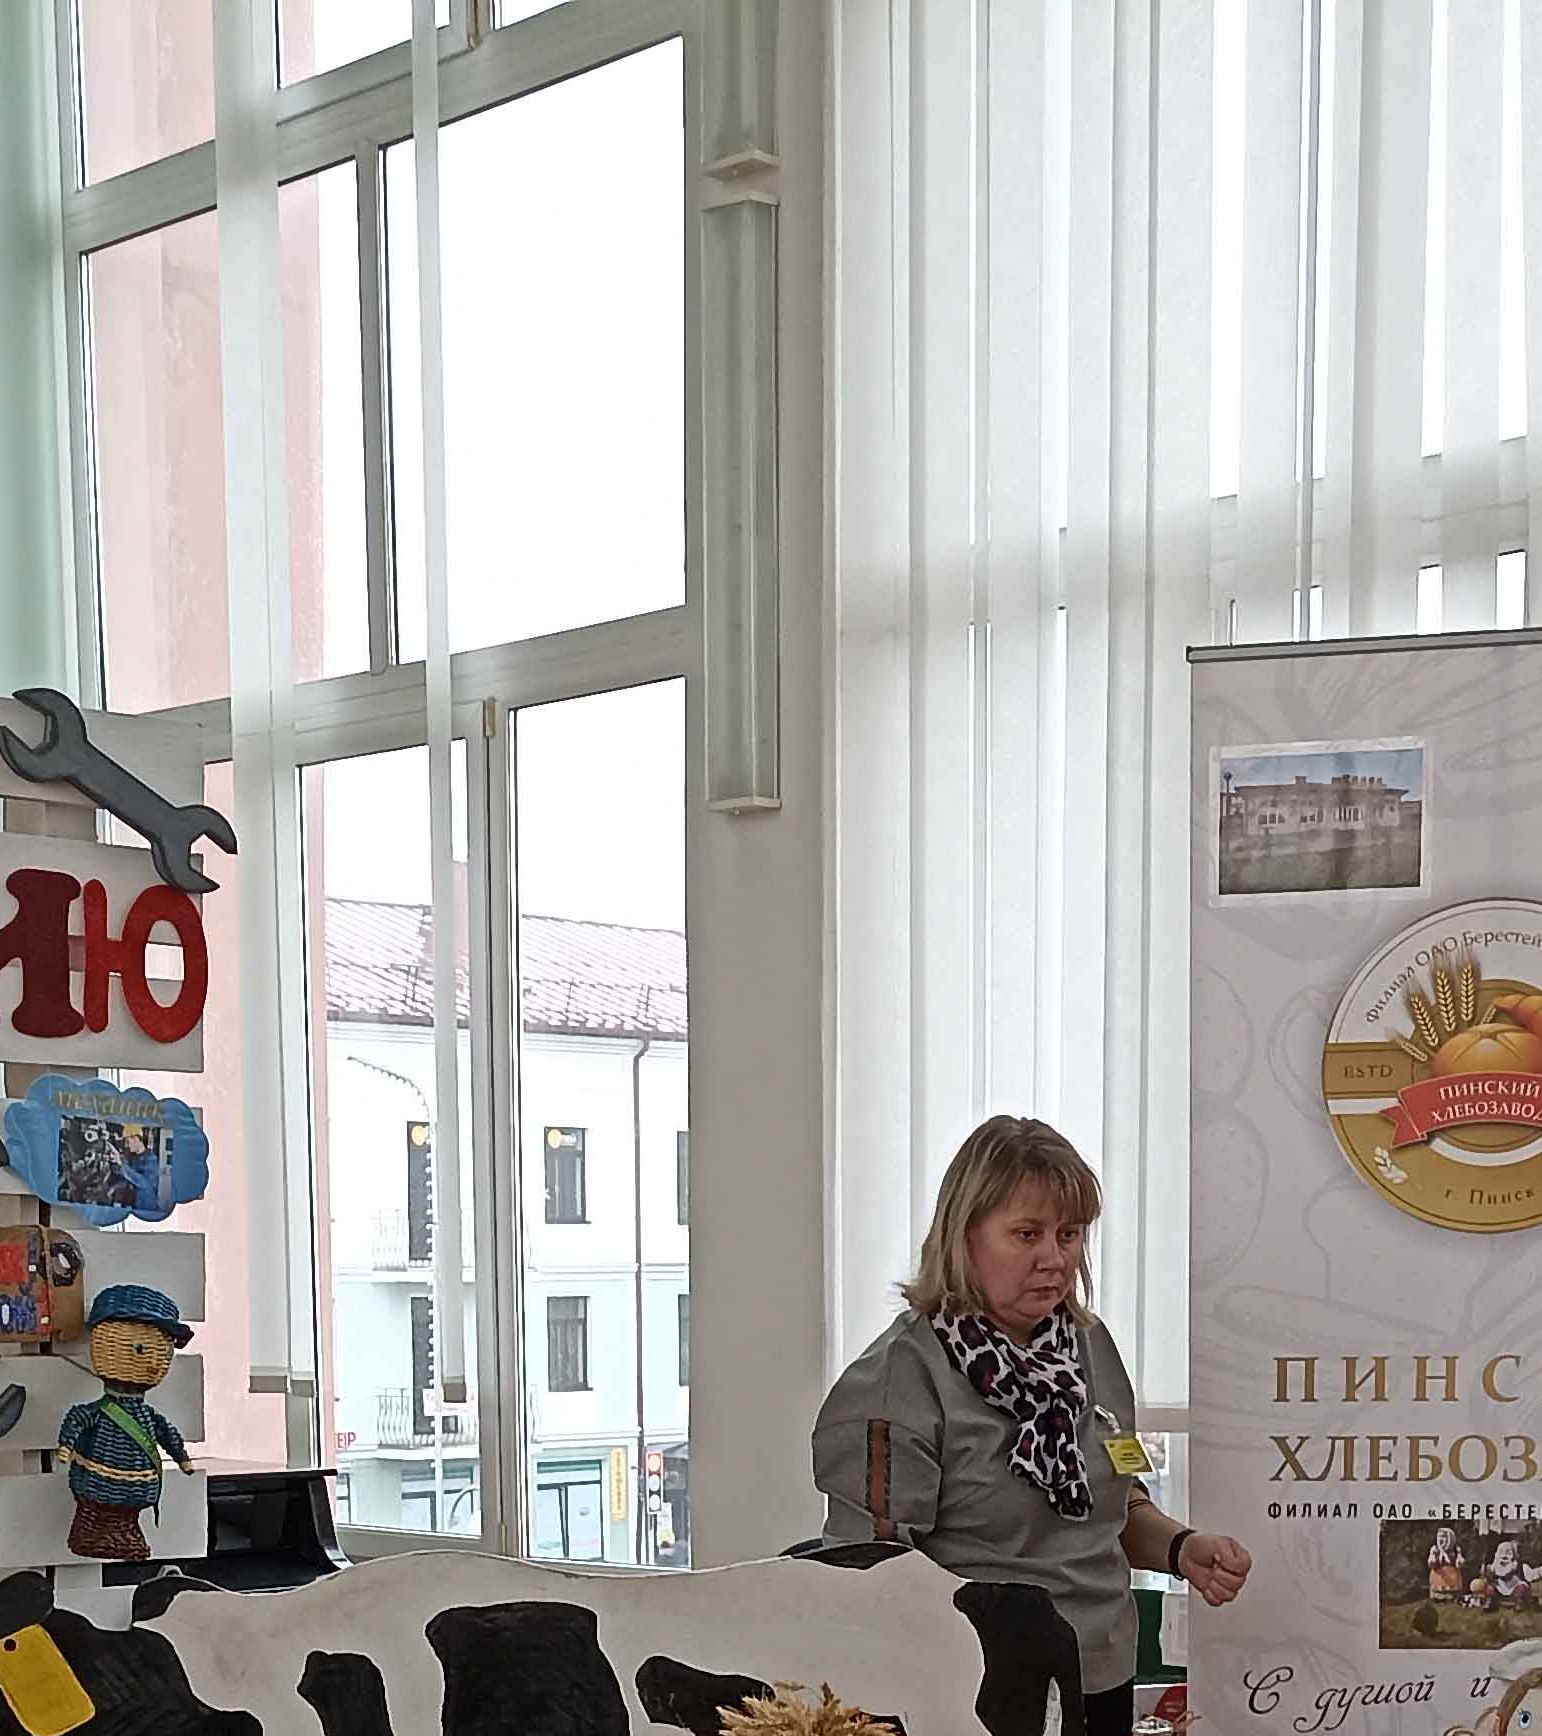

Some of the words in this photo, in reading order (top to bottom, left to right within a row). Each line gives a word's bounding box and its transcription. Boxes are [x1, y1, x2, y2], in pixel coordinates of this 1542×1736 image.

[1366, 966, 1415, 1023] Филиал
[1344, 1065, 1393, 1078] ESTD
[1440, 1080, 1541, 1099] ПИНСКИЙ
[1469, 1187, 1535, 1205] Пинск
[1268, 1502, 1358, 1520] ФИЛИАЛ
[1373, 1502, 1413, 1520] ОАО
[1243, 1666, 1293, 1714] С
[1293, 1672, 1436, 1734] душой
